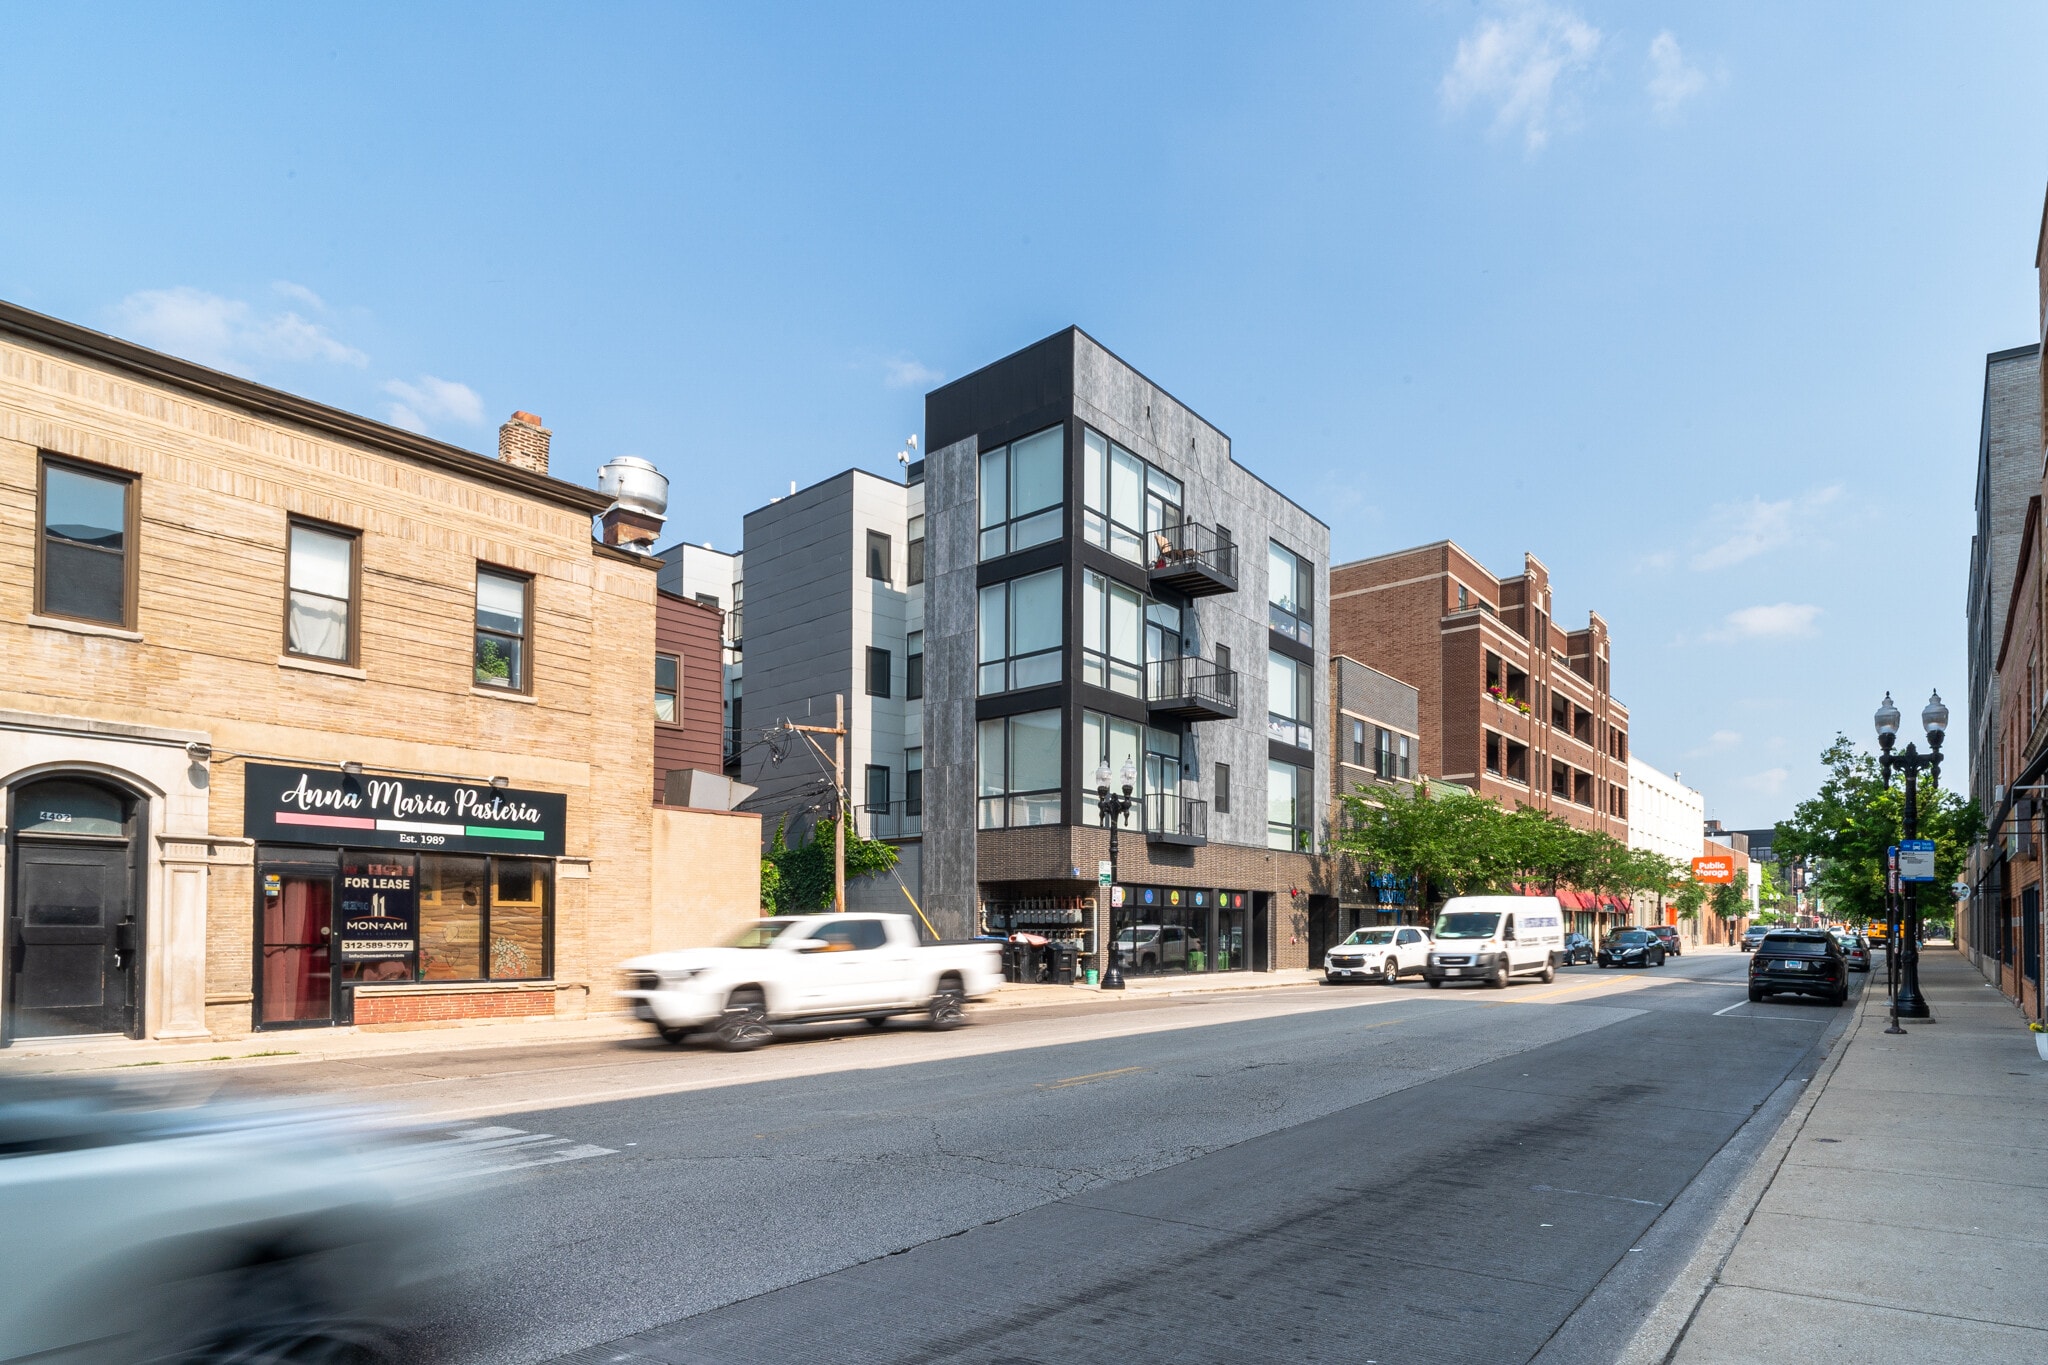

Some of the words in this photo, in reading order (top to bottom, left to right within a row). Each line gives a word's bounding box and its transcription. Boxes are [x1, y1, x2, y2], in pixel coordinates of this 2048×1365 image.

[281, 773, 362, 811] Anna
[367, 780, 450, 818] Maria
[454, 788, 541, 823] Pasteria
[399, 833, 418, 844] Est.
[420, 835, 446, 845] 1989
[1698, 861, 1726, 869] Public
[344, 877, 370, 888] FOR
[372, 878, 411, 890] LEASE
[346, 921, 378, 930] MON
[383, 922, 408, 930] AMI
